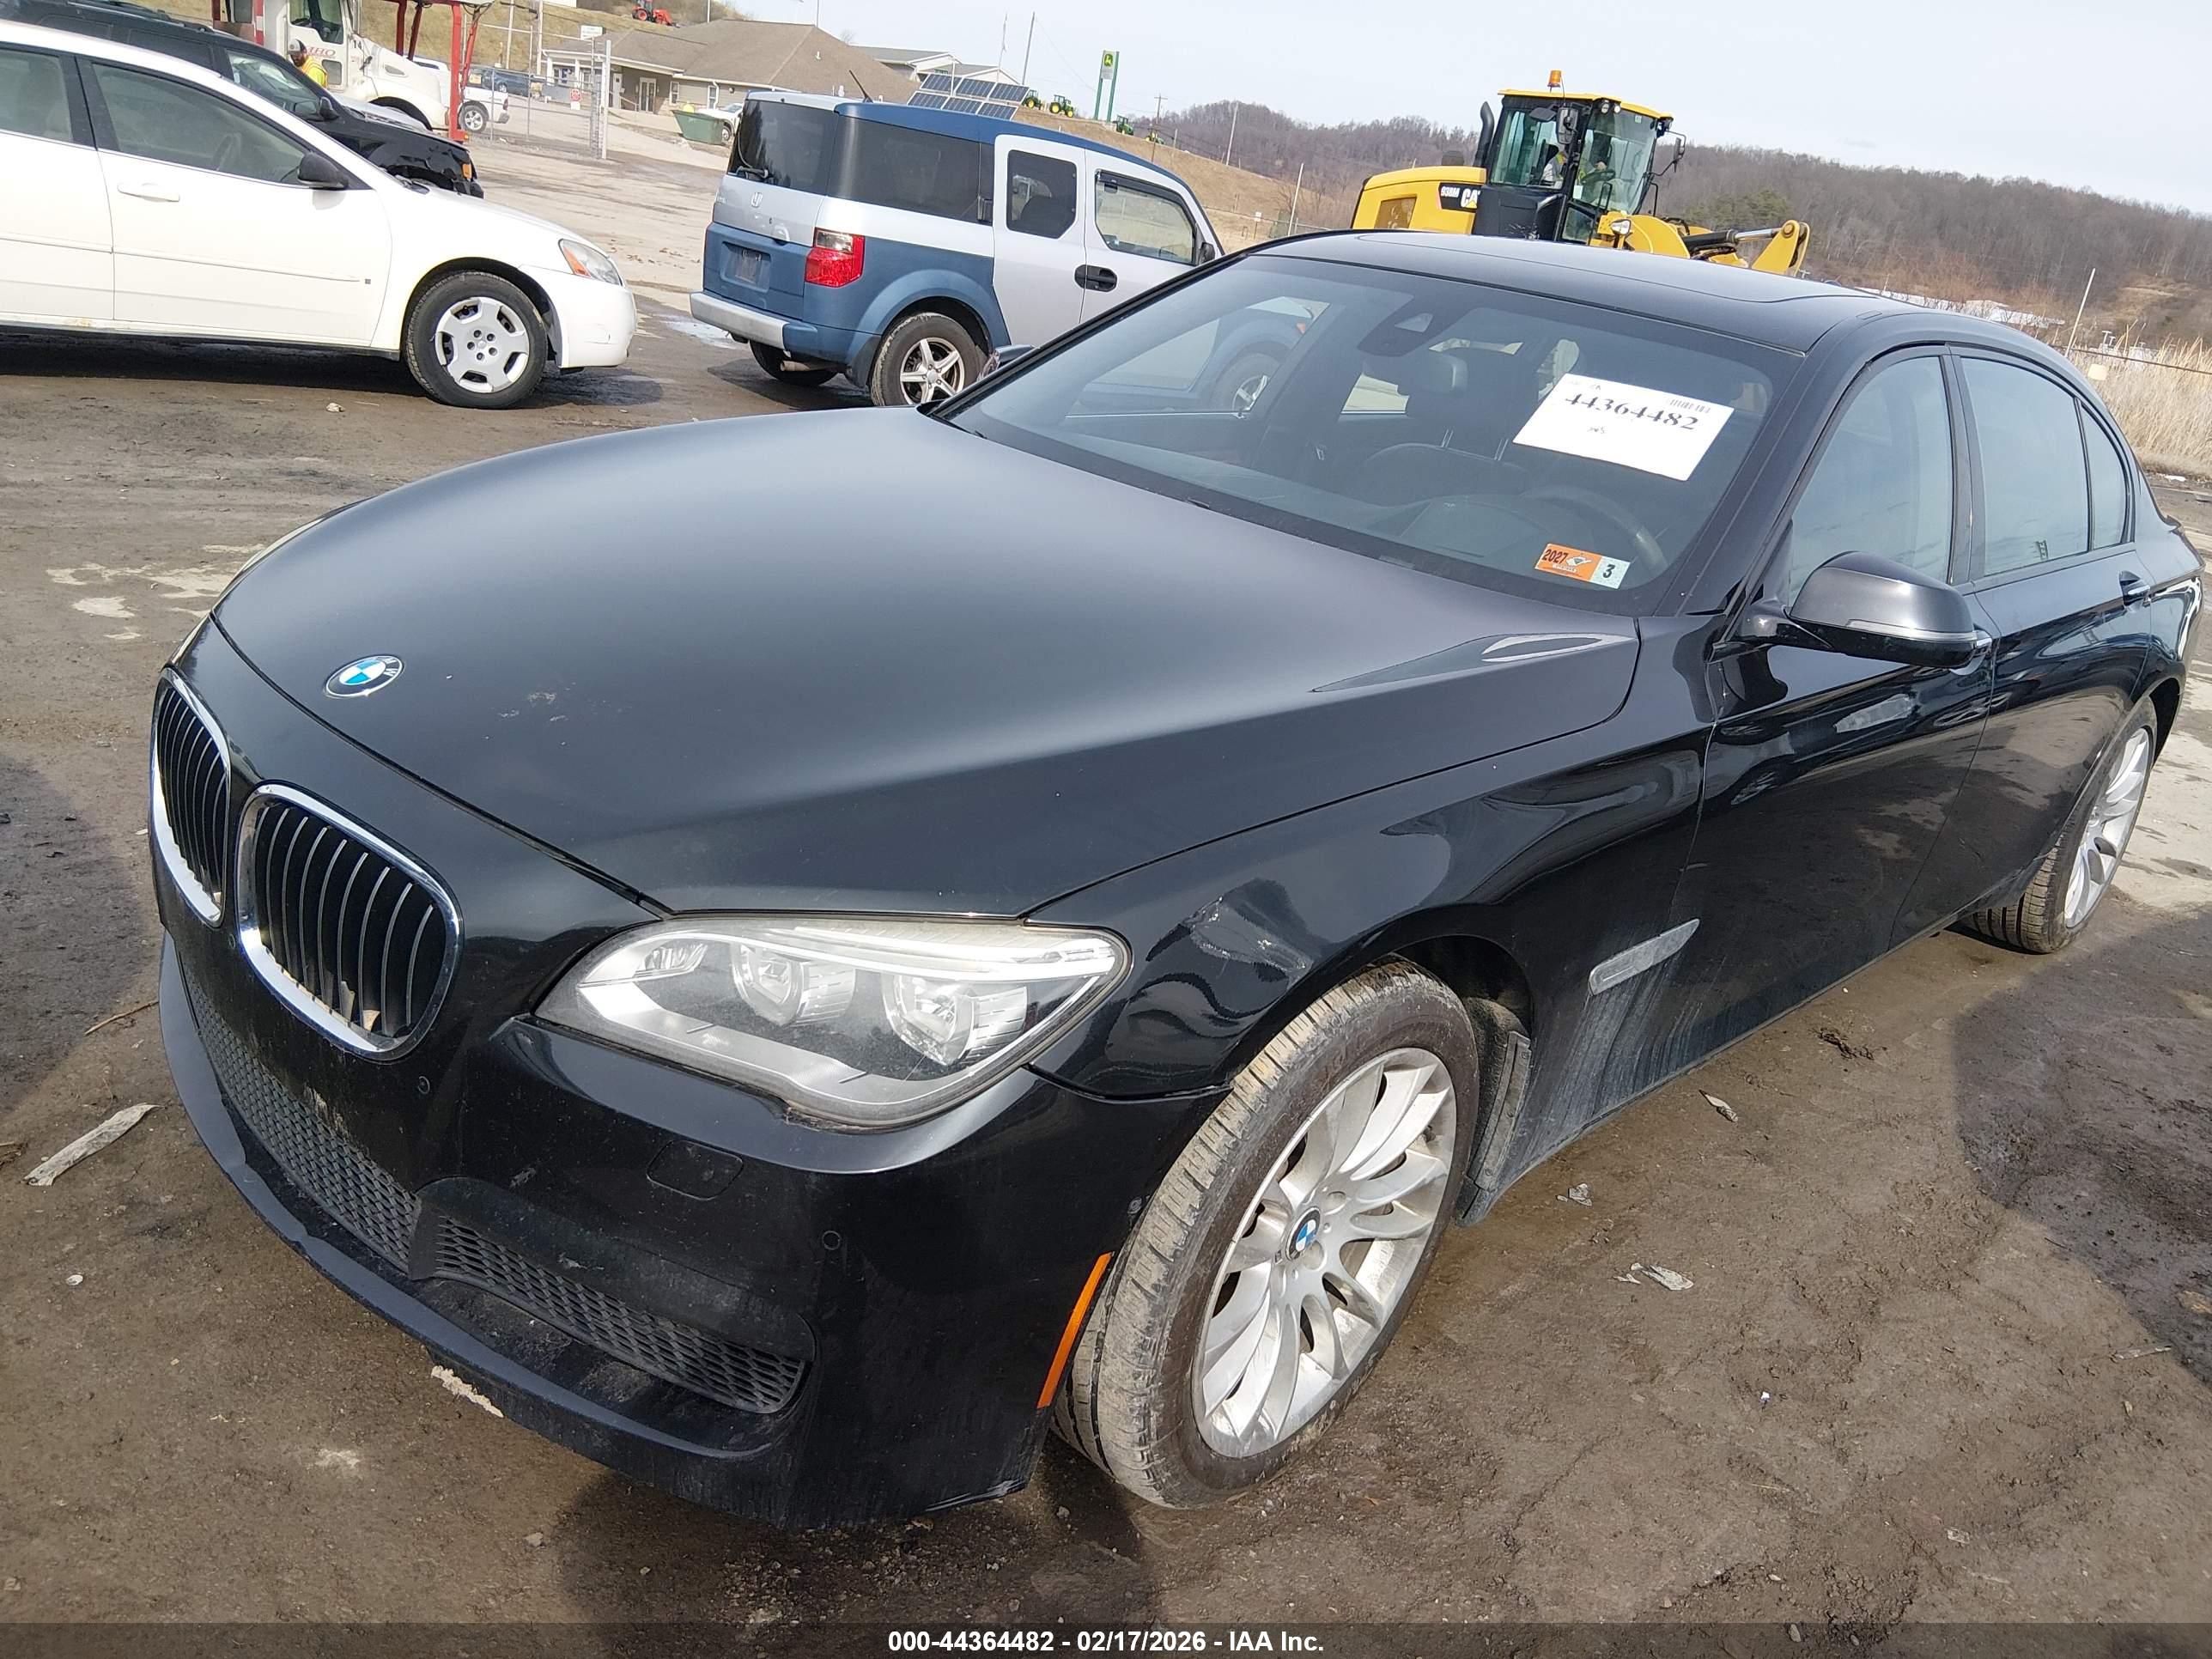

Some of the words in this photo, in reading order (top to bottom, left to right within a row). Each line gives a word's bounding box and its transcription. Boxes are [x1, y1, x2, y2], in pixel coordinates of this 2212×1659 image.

[1461, 188, 1481, 209] CA
[1565, 393, 1699, 430] 44364482
[1541, 549, 1569, 564] 2027
[1602, 563, 1616, 578] 3
